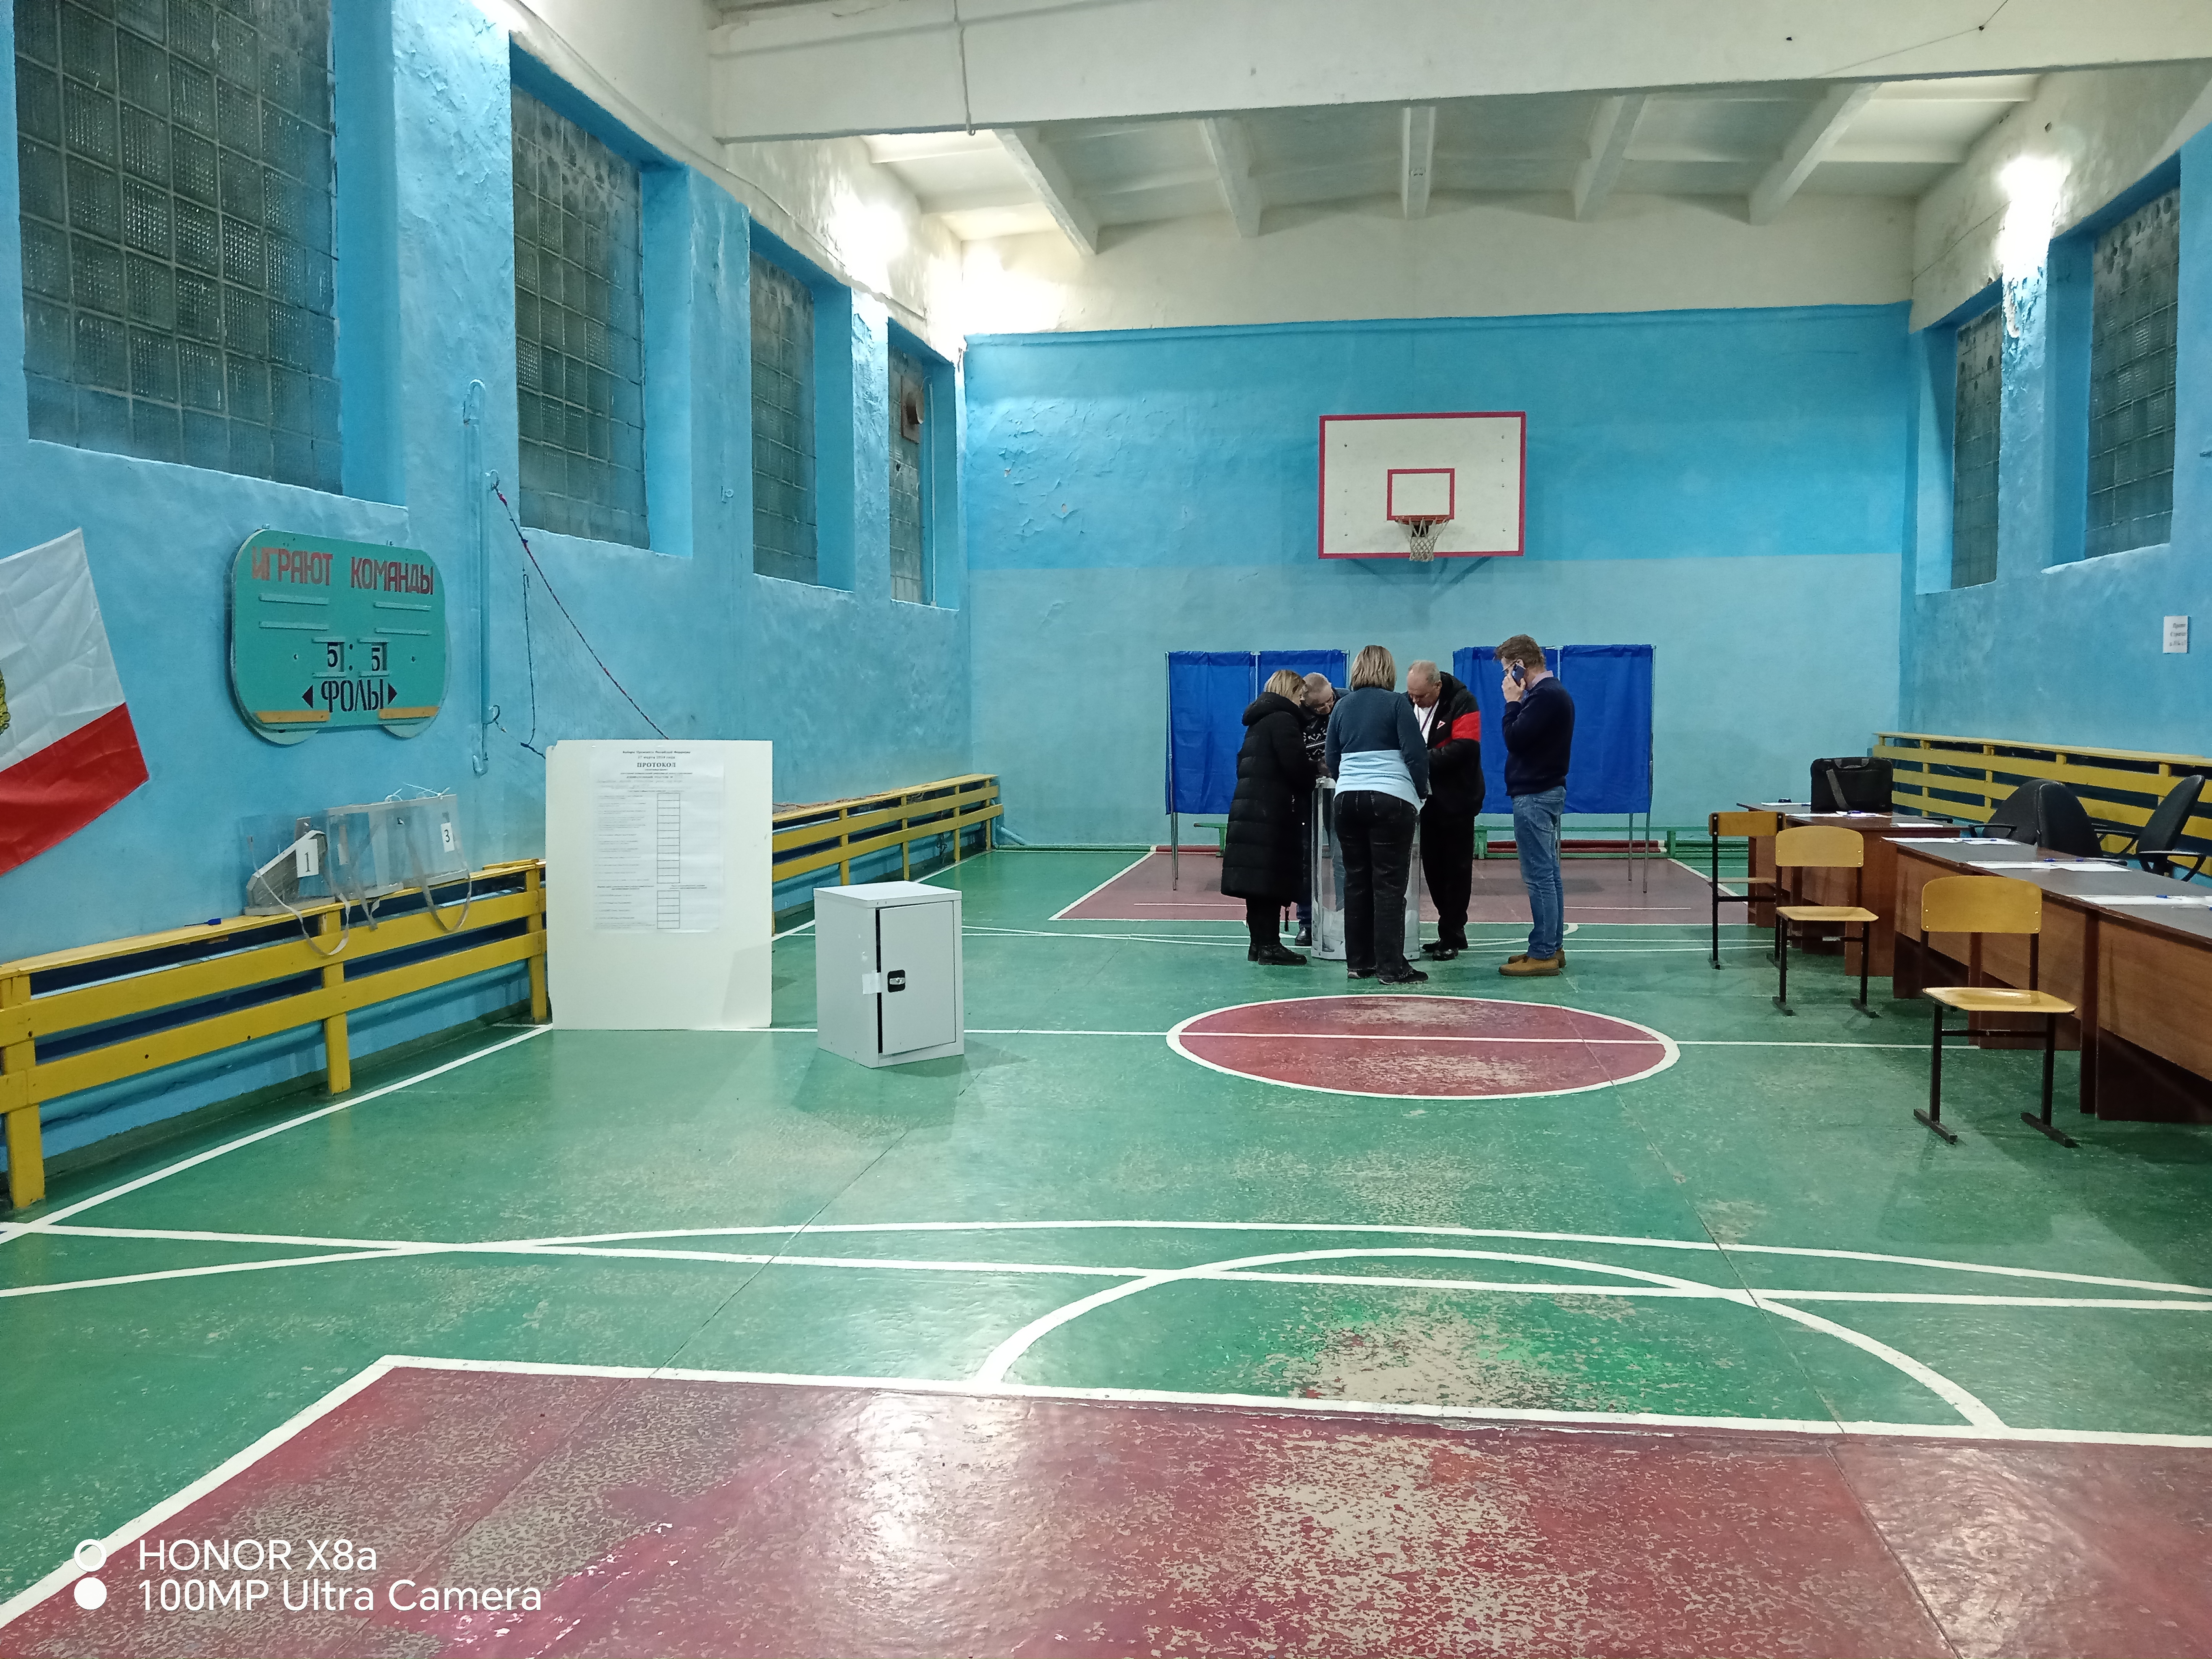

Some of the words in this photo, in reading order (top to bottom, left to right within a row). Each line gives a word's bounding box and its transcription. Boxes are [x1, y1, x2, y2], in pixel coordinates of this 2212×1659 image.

[252, 547, 333, 586] ИГРАЮТ
[351, 556, 434, 595] КОМАНДЫ
[321, 679, 383, 713] ФОЛЫ
[444, 829, 450, 842] 3
[304, 852, 311, 872] 1
